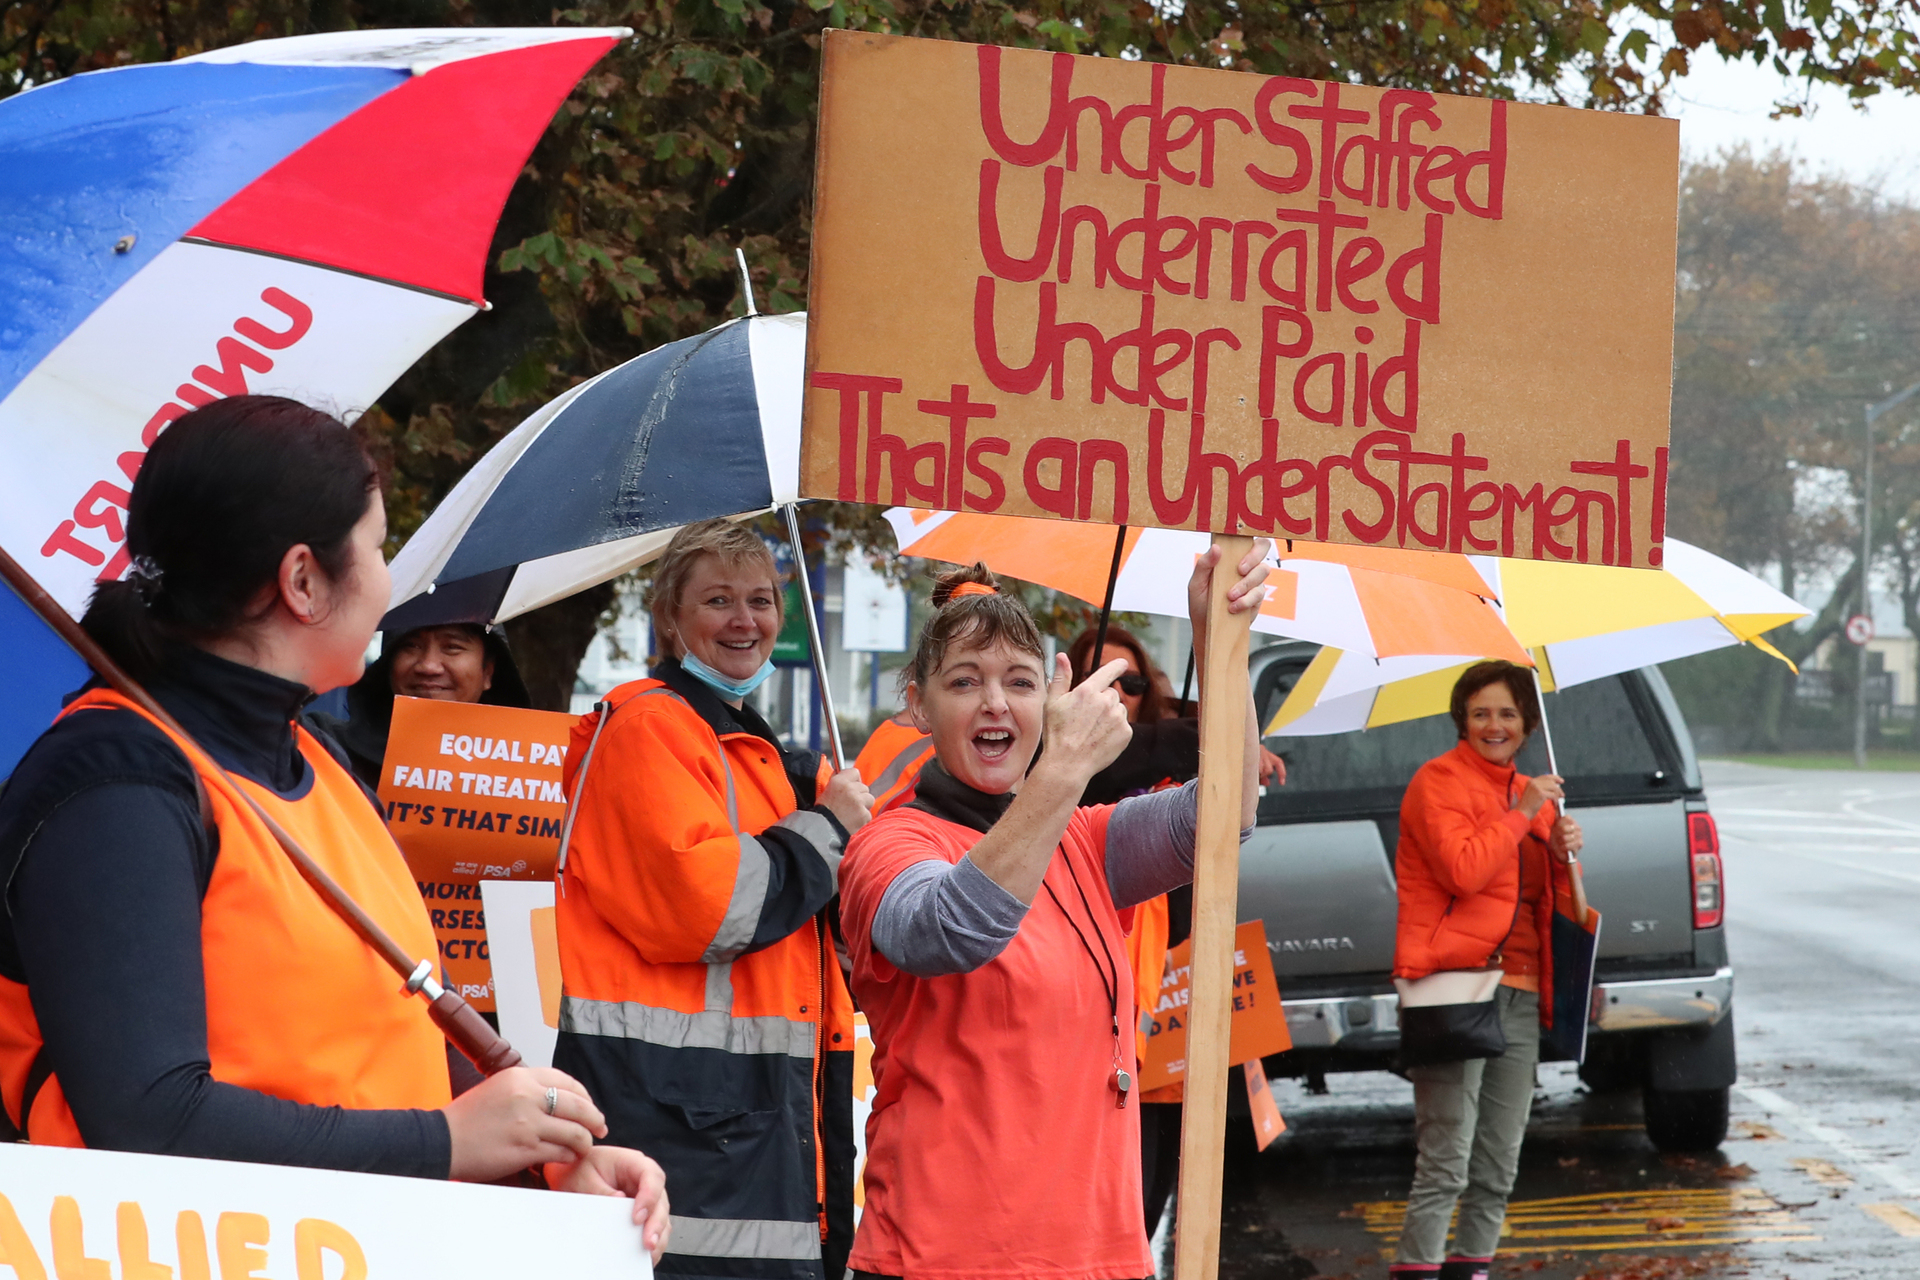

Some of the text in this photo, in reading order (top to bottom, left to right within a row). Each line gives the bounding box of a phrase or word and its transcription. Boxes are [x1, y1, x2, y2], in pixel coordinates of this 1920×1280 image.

[978, 158, 1443, 325] Underrated
[974, 275, 1422, 433] Under Paid
[811, 371, 1010, 513] Thats
[1023, 436, 1129, 525] an
[439, 733, 524, 763] EQUAL
[393, 764, 568, 804] FAIR TREATM
[387, 801, 561, 839] IT'S THAT SIM
[483, 865, 512, 877] PSA
[427, 909, 485, 930] RSES
[1630, 920, 1659, 933] ST
[1266, 936, 1355, 953] NAVARA
[461, 984, 489, 998] PSA
[1153, 989, 1189, 1014] AIS
